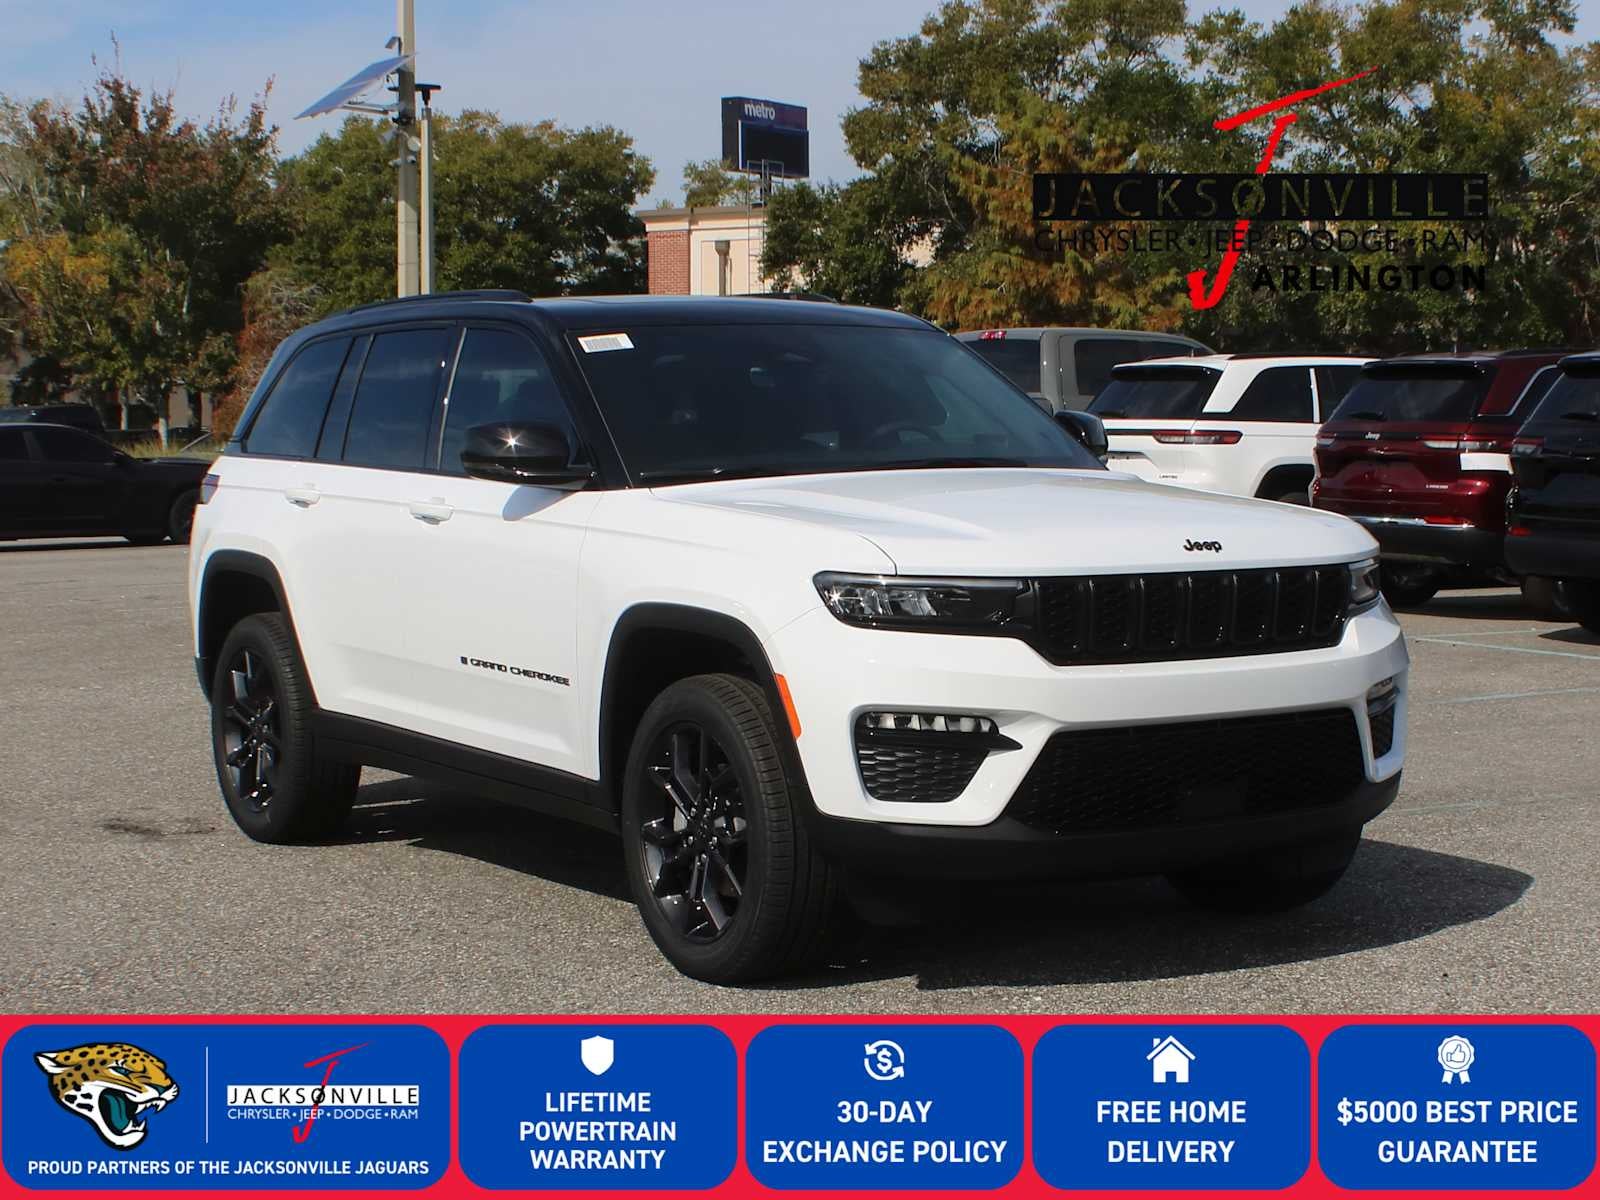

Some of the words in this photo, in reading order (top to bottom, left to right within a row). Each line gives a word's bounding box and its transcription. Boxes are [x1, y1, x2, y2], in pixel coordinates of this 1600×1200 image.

[744, 101, 776, 121] metro
[1183, 538, 1223, 554] Jeep
[470, 658, 507, 673] GRAND
[510, 666, 571, 686] CHEROKEE
